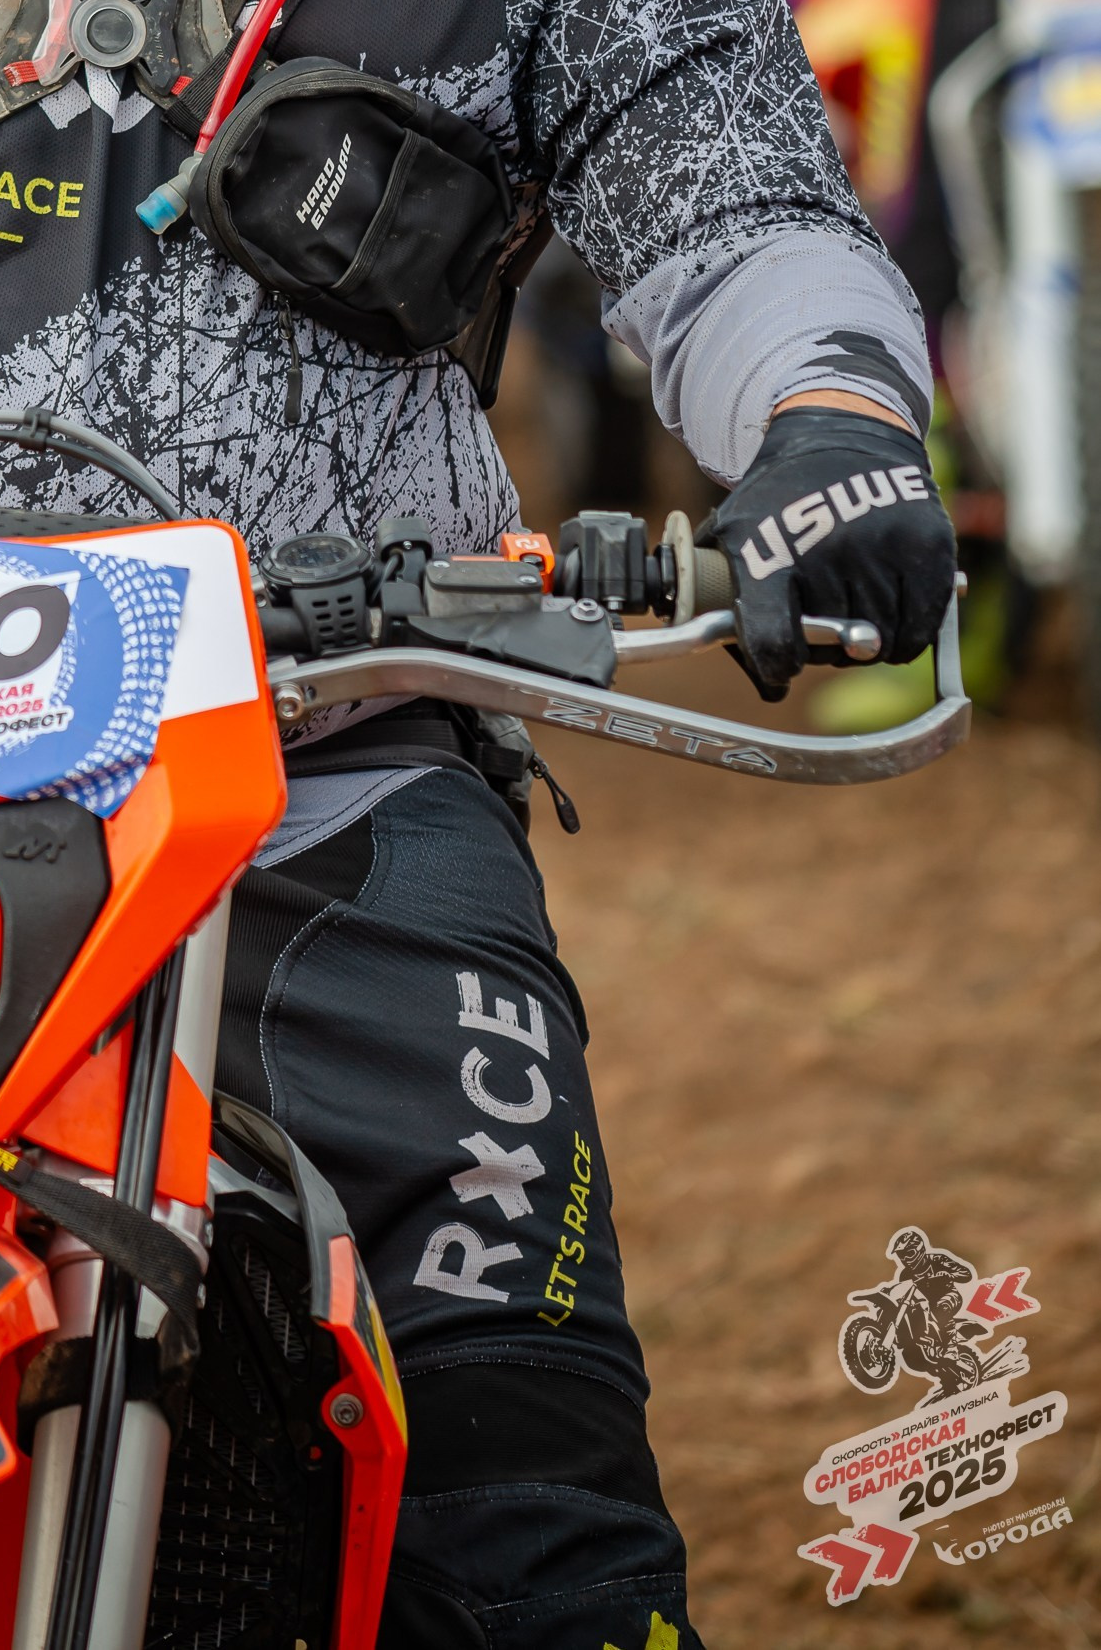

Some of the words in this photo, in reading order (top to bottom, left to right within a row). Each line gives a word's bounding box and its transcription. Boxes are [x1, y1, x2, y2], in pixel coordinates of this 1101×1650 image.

[295, 157, 335, 224] HARD
[310, 133, 352, 230] ENDURO
[740, 465, 930, 580] USWE
[542, 695, 777, 774] ZETA
[537, 1234, 586, 1327] LET'S
[563, 1131, 591, 1236] RACE
